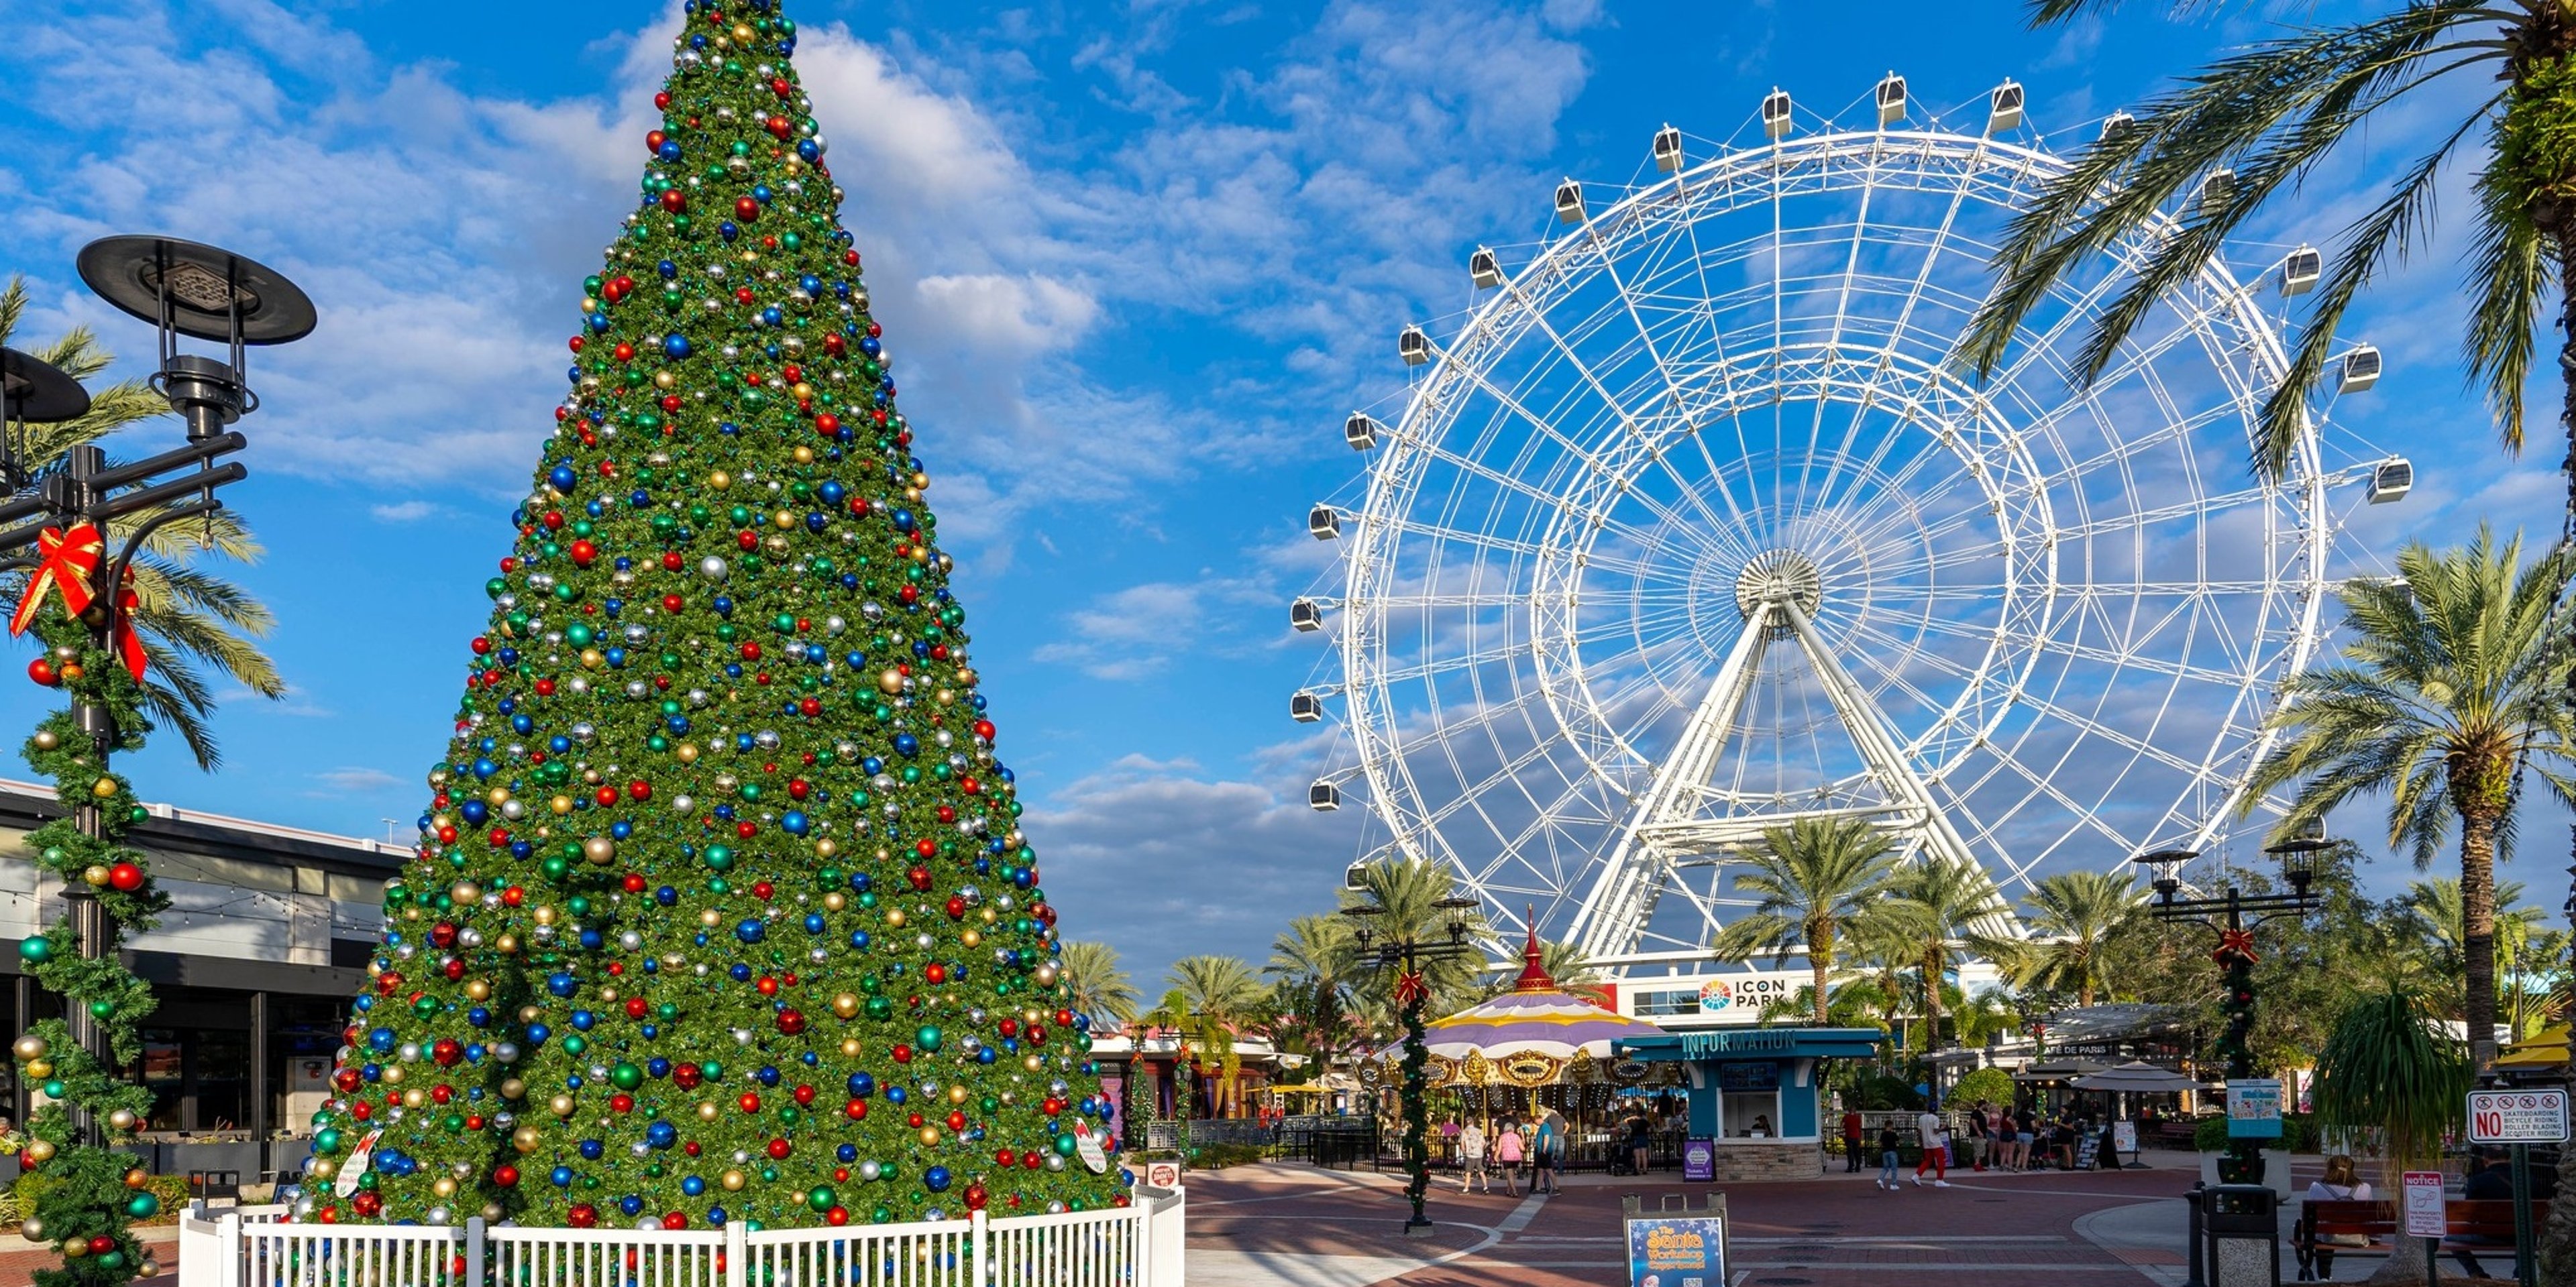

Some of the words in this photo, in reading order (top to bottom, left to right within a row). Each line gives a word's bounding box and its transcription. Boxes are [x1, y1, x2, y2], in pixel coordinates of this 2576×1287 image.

[1736, 979, 1785, 993] ICON
[1682, 1030, 1796, 1052] INFORMATION
[2043, 1045, 2062, 1054] AFÉ
[2080, 1046, 2106, 1054] PARIS
[2476, 1111, 2502, 1137] NO
[2406, 1177, 2439, 1185] NOTICE
[1658, 1226, 1675, 1235] The
[1647, 1230, 1704, 1249] Santa
[1647, 1249, 1705, 1261] Workshop
